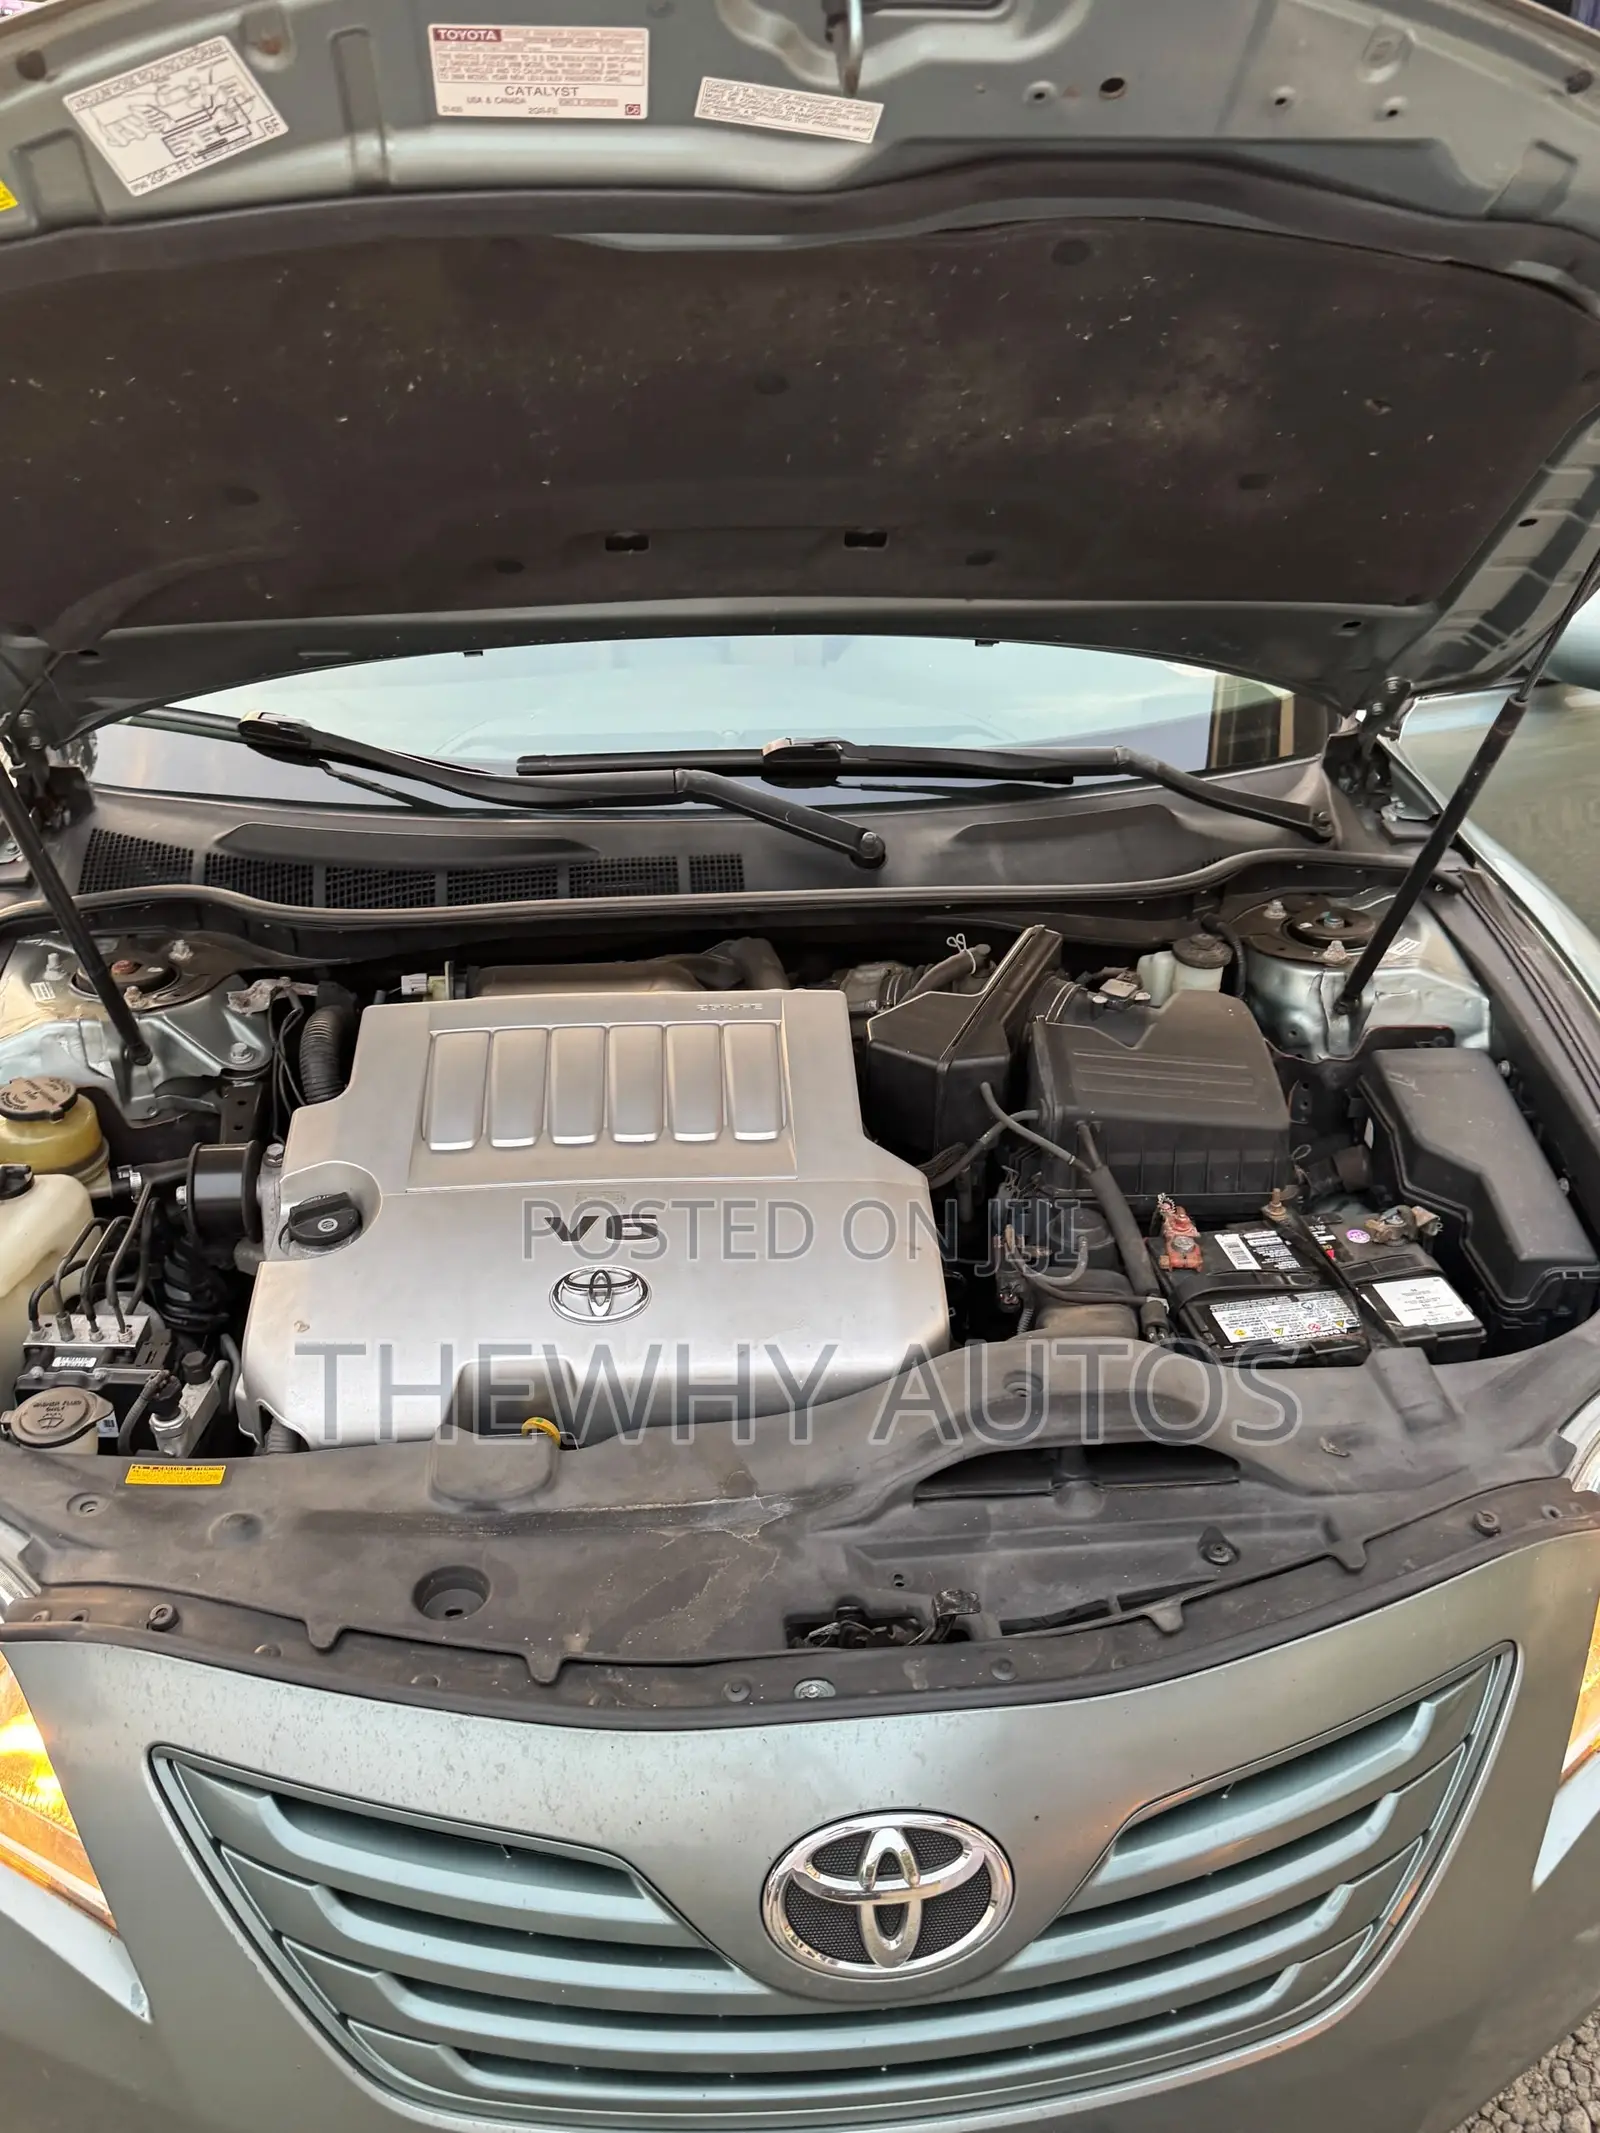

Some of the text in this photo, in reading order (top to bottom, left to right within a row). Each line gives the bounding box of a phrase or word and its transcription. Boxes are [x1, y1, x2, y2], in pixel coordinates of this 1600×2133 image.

[437, 29, 498, 41] TOYOTA
[504, 85, 580, 97] CATALYST
[466, 96, 482, 104] USA
[543, 1213, 659, 1244] V6
